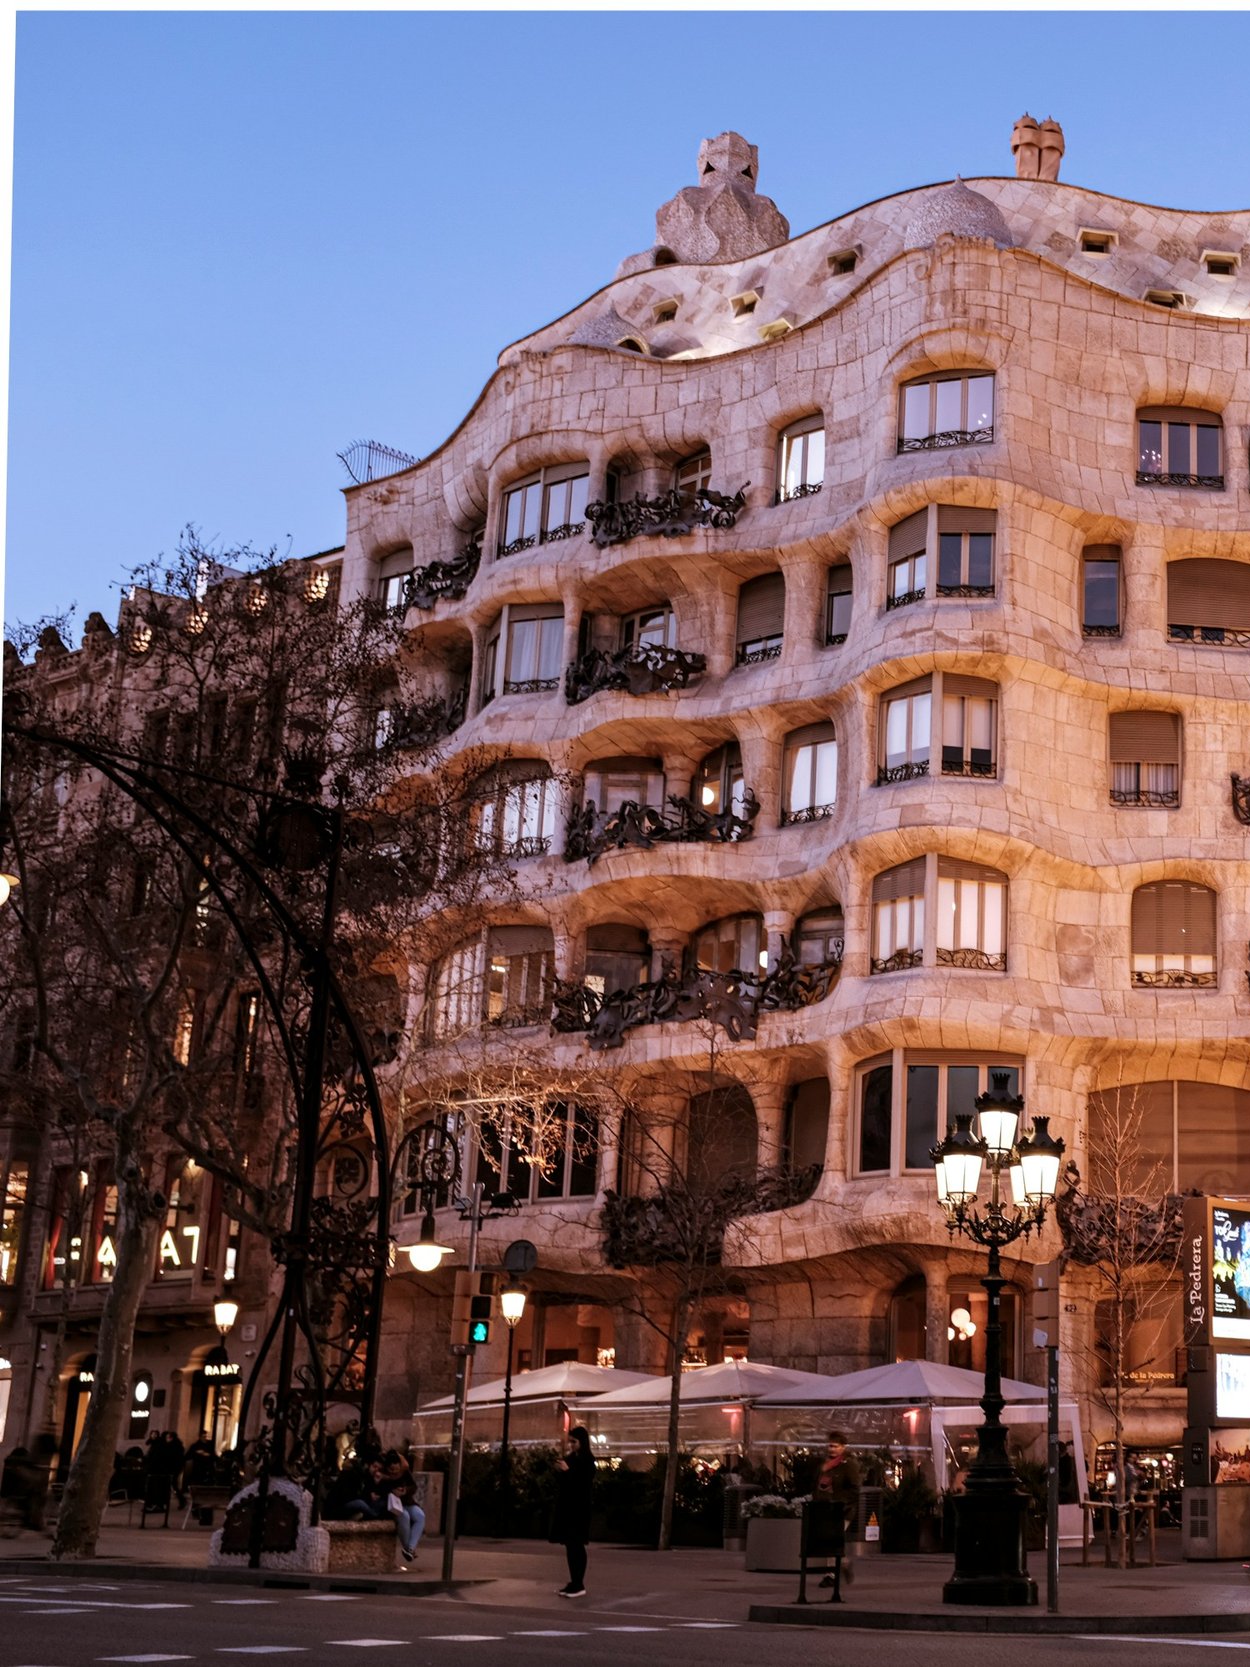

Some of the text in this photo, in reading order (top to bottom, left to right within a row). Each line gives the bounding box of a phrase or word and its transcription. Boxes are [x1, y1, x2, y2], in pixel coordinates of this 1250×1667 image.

[1189, 1235, 1205, 1324] La Pedrera
[204, 1364, 239, 1376] RABAT
[1129, 1371, 1138, 1379] de
[1139, 1371, 1147, 1379] la
[1148, 1371, 1175, 1379] Pedrera
